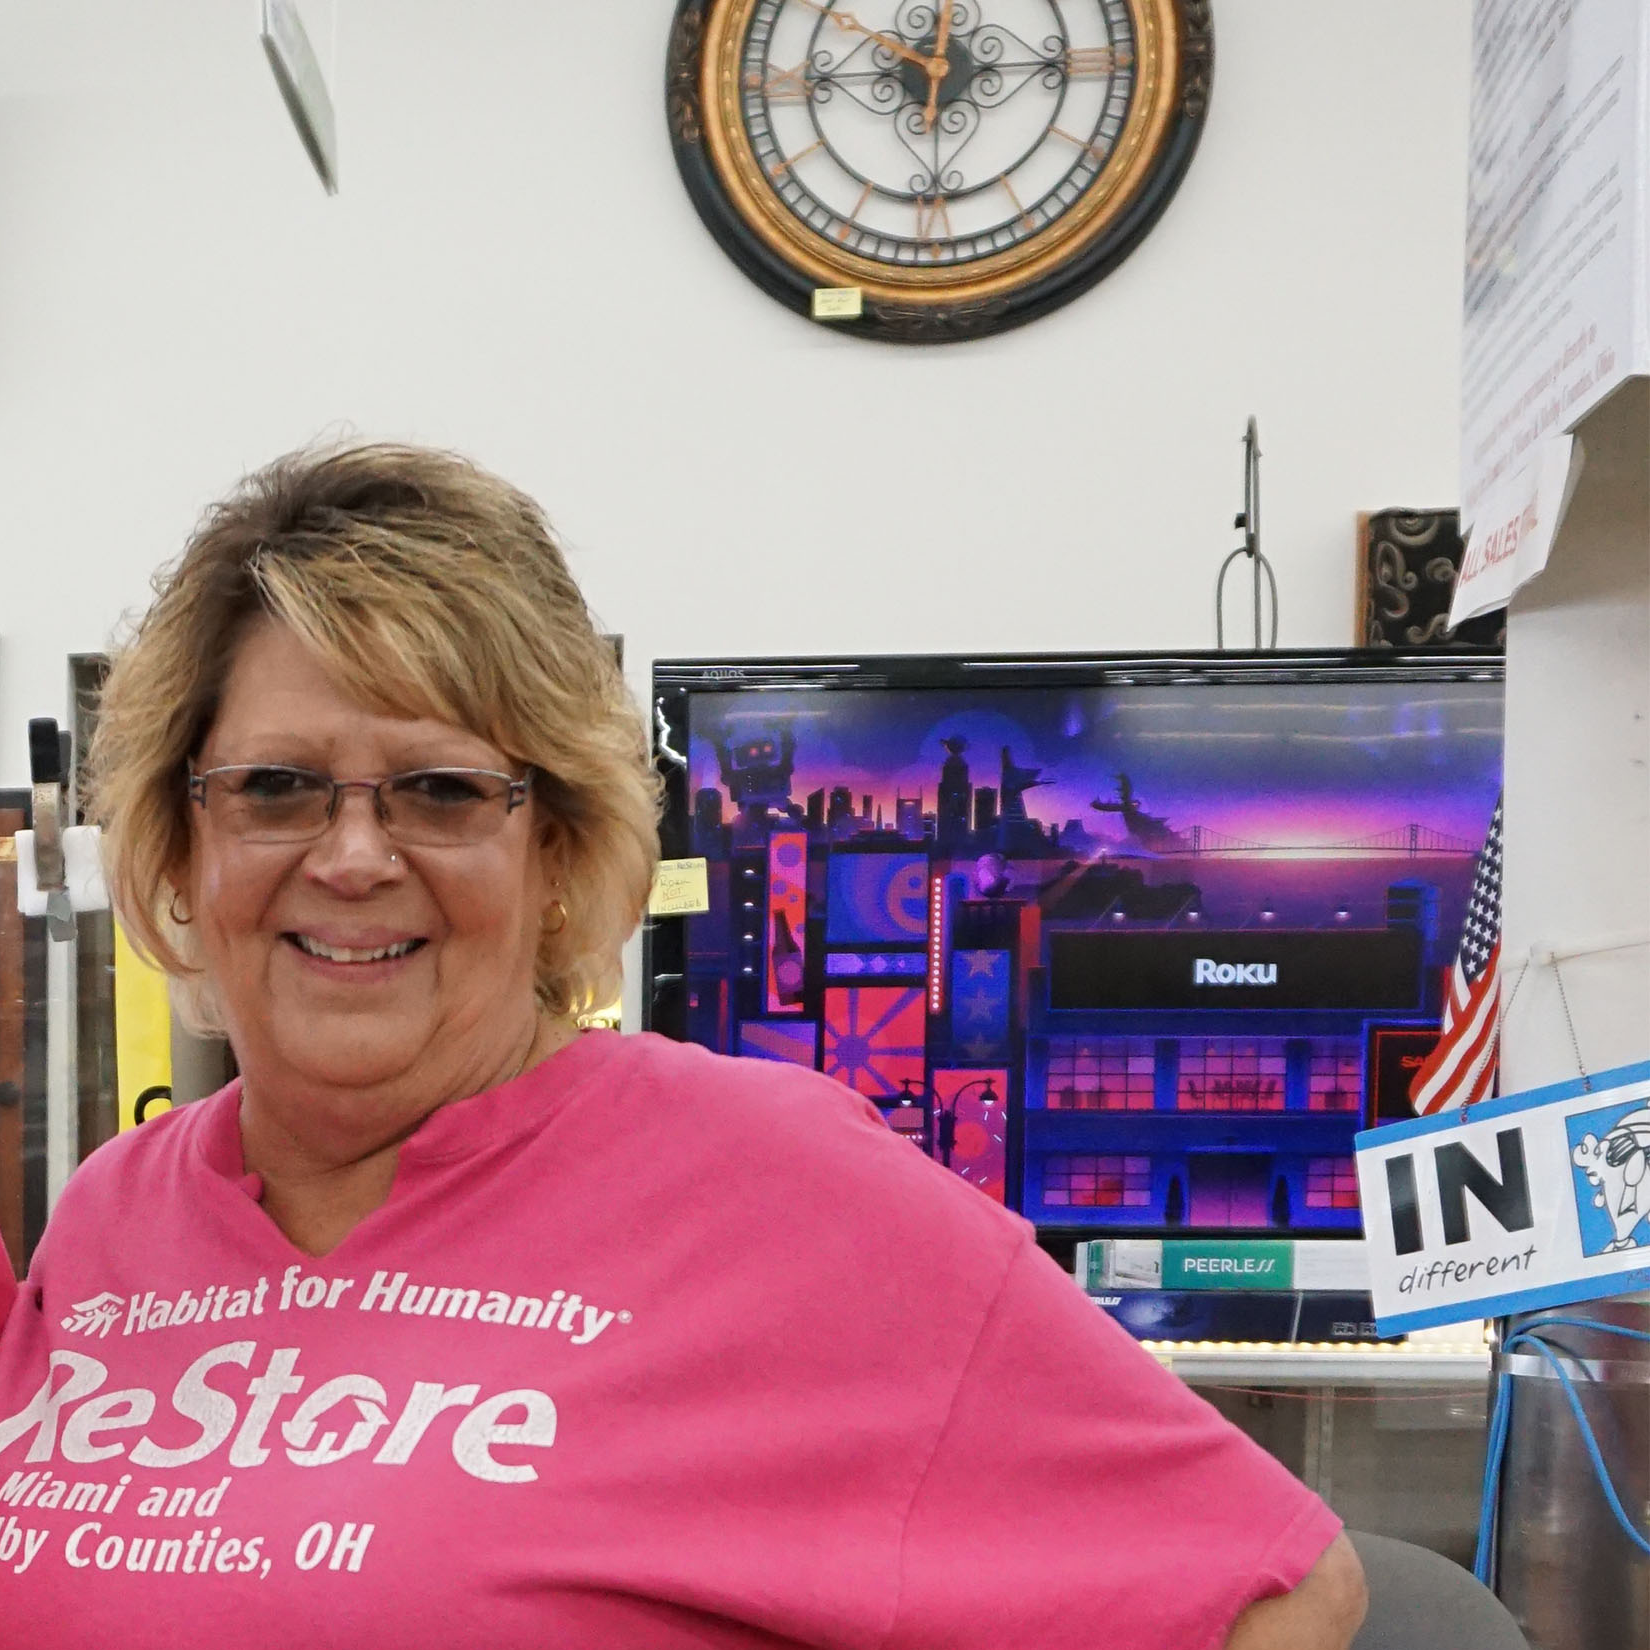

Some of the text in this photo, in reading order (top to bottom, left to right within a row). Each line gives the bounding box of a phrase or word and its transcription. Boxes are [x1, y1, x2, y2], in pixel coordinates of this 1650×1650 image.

[702, 669, 745, 680] AQUOS
[1194, 958, 1278, 985] Roku
[1385, 1127, 1534, 1256] IN
[1398, 1245, 1538, 1295] different
[122, 1265, 615, 1345] Habitat for Humanity
[137, 1476, 232, 1518] and
[64, 1522, 272, 1580] Counties,
[295, 1521, 375, 1573] OH
